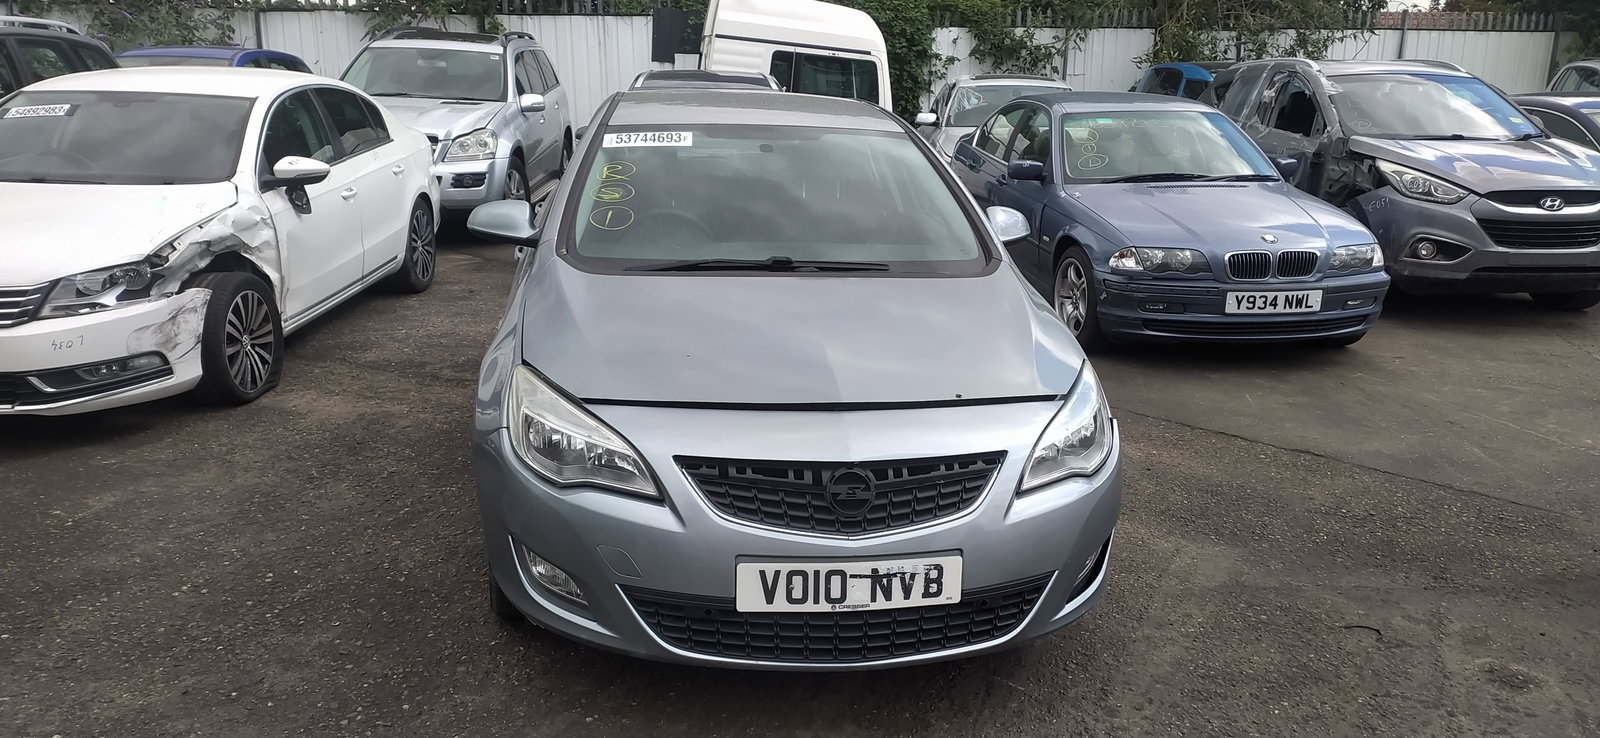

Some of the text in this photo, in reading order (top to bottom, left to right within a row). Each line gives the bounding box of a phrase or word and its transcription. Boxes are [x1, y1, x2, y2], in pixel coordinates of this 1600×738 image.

[1235, 293, 1313, 310] Y934 NWL
[870, 563, 943, 603] NVB
